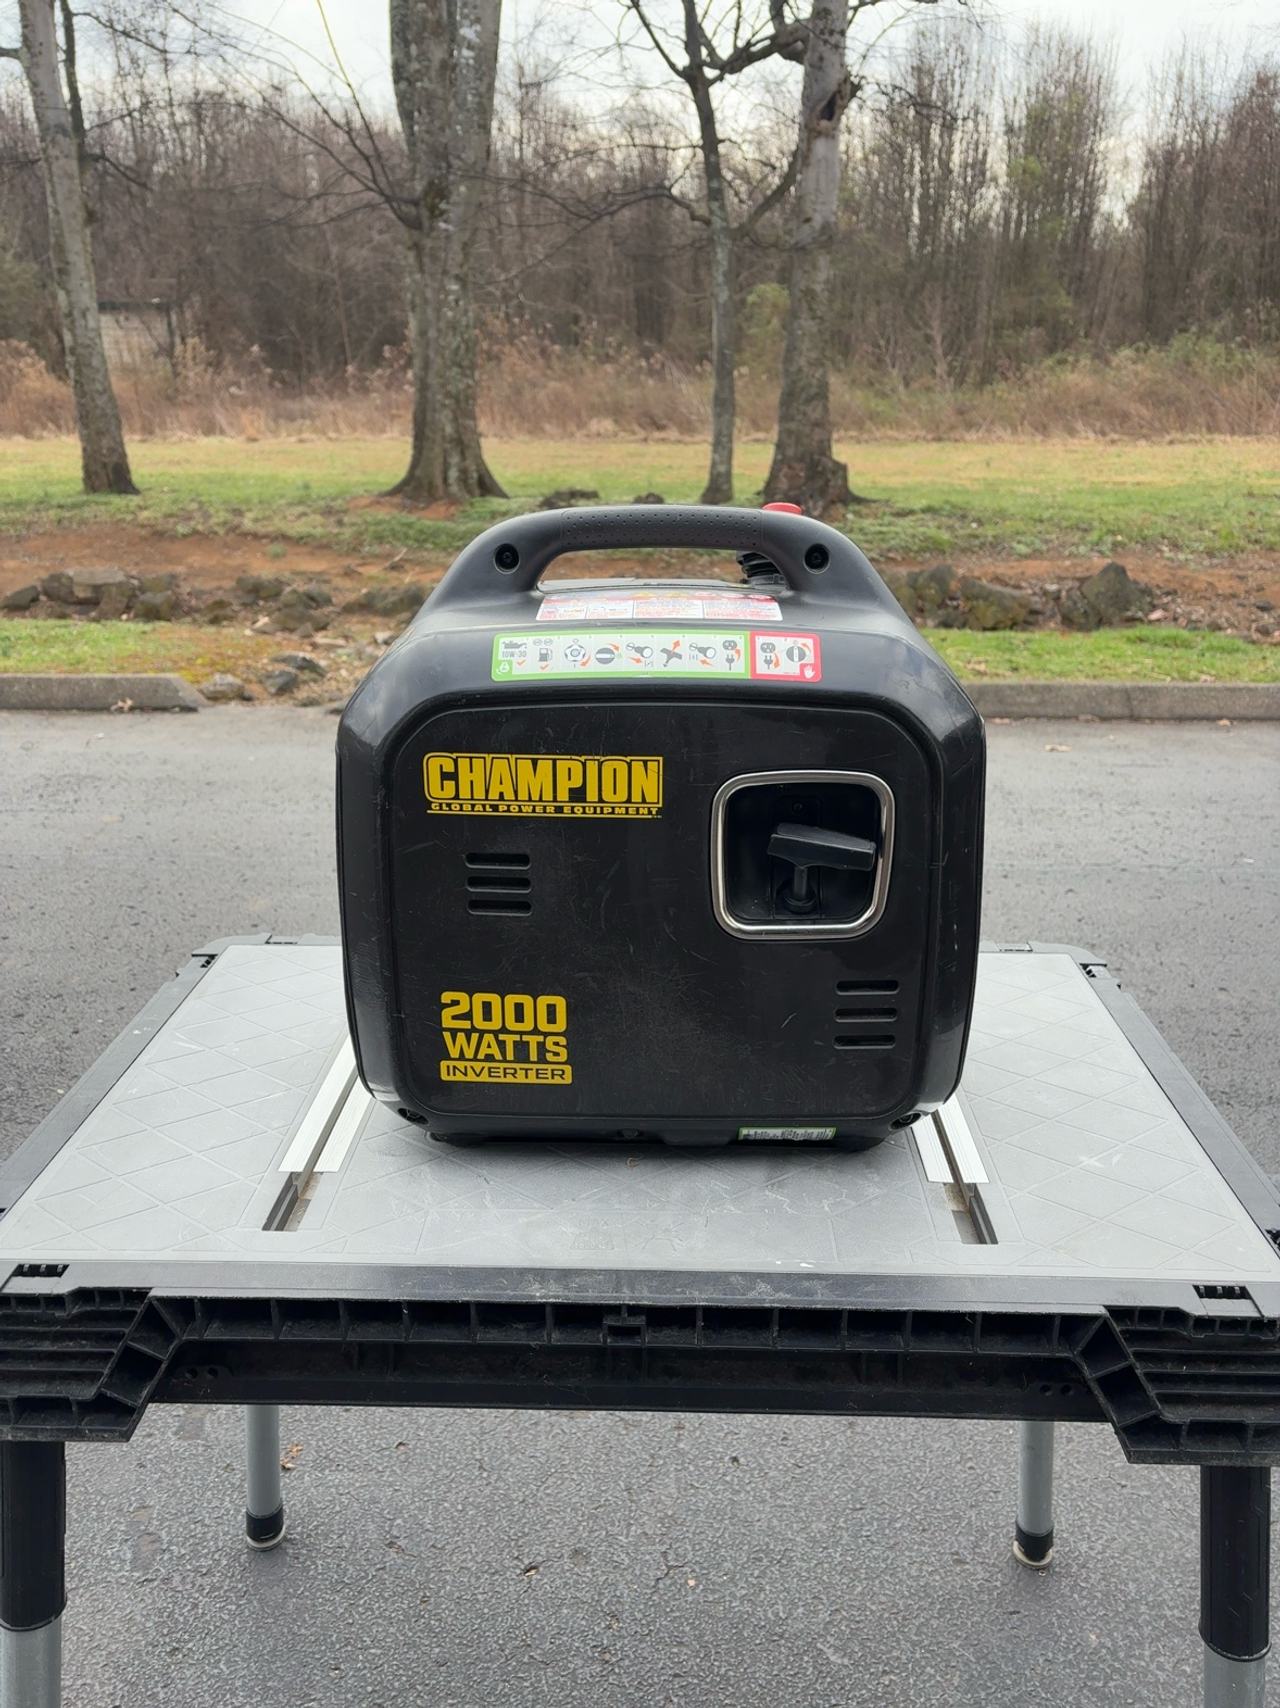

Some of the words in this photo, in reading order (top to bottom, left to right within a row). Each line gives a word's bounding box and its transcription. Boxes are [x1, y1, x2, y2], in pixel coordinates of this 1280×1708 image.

[426, 755, 660, 804] CHAMPION
[431, 803, 493, 812] GLOBAL
[498, 804, 555, 813] POWER
[563, 806, 659, 815] EQUIPMENT
[441, 991, 567, 1033] 2000
[442, 1031, 568, 1062] WATTS
[446, 1065, 566, 1080] INVERTER
